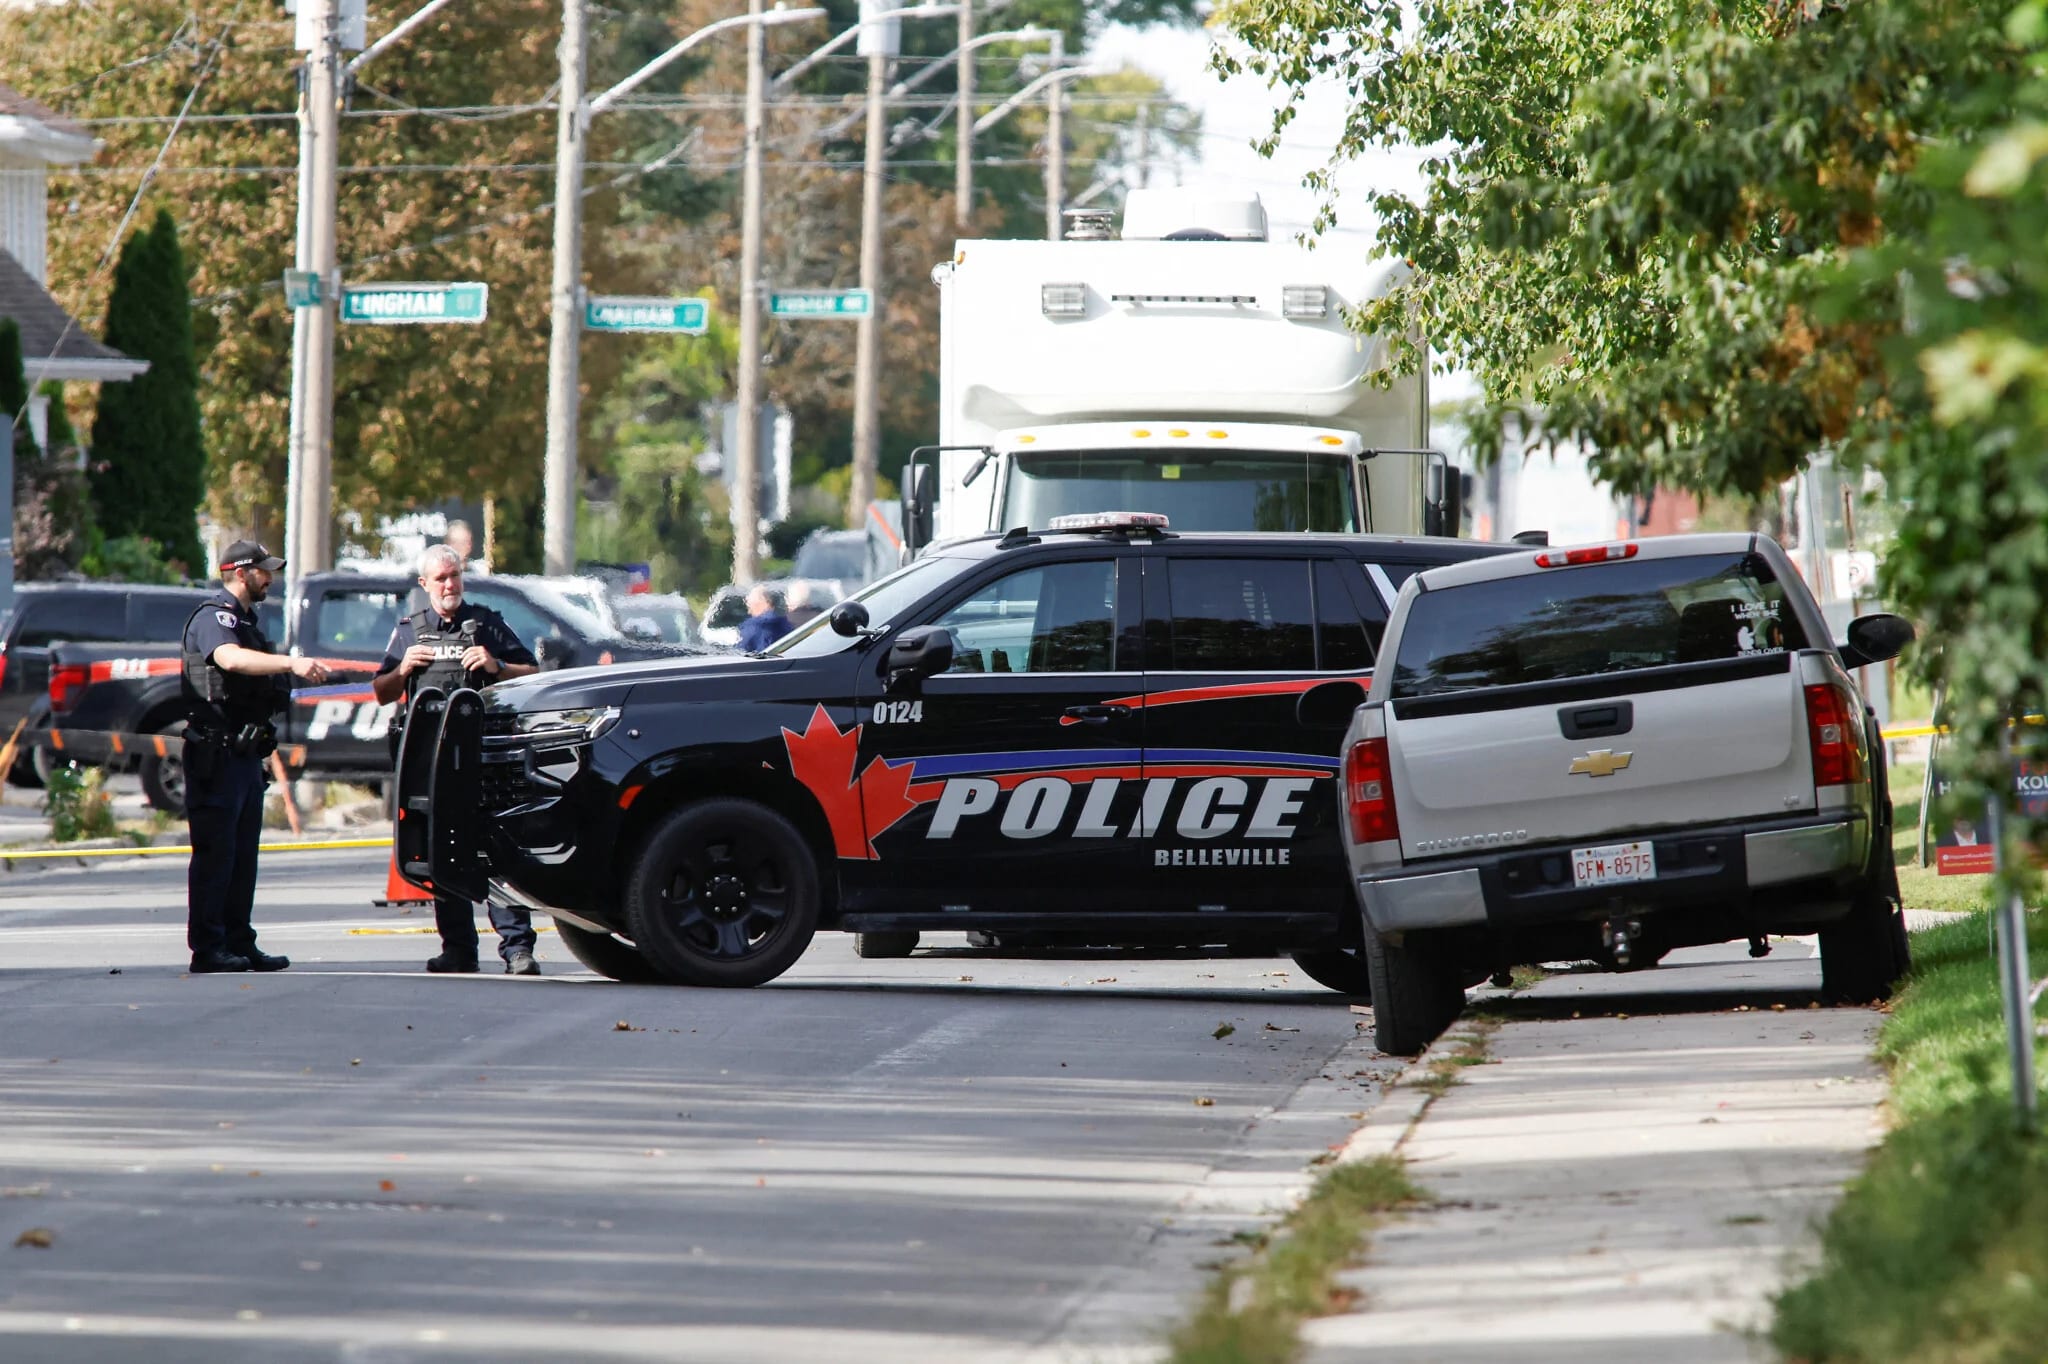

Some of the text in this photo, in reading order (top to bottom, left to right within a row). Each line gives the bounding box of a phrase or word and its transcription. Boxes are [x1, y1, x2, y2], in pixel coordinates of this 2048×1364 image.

[351, 292, 446, 315] LINGHAM
[1740, 601, 1766, 612] LOVE
[1770, 600, 1780, 609] IT
[433, 645, 464, 660] OLICE
[873, 700, 923, 725] 0124
[925, 776, 1316, 840] POLICE
[1416, 829, 1528, 852] SILVERADO
[1154, 848, 1291, 867] BELLEVILLE
